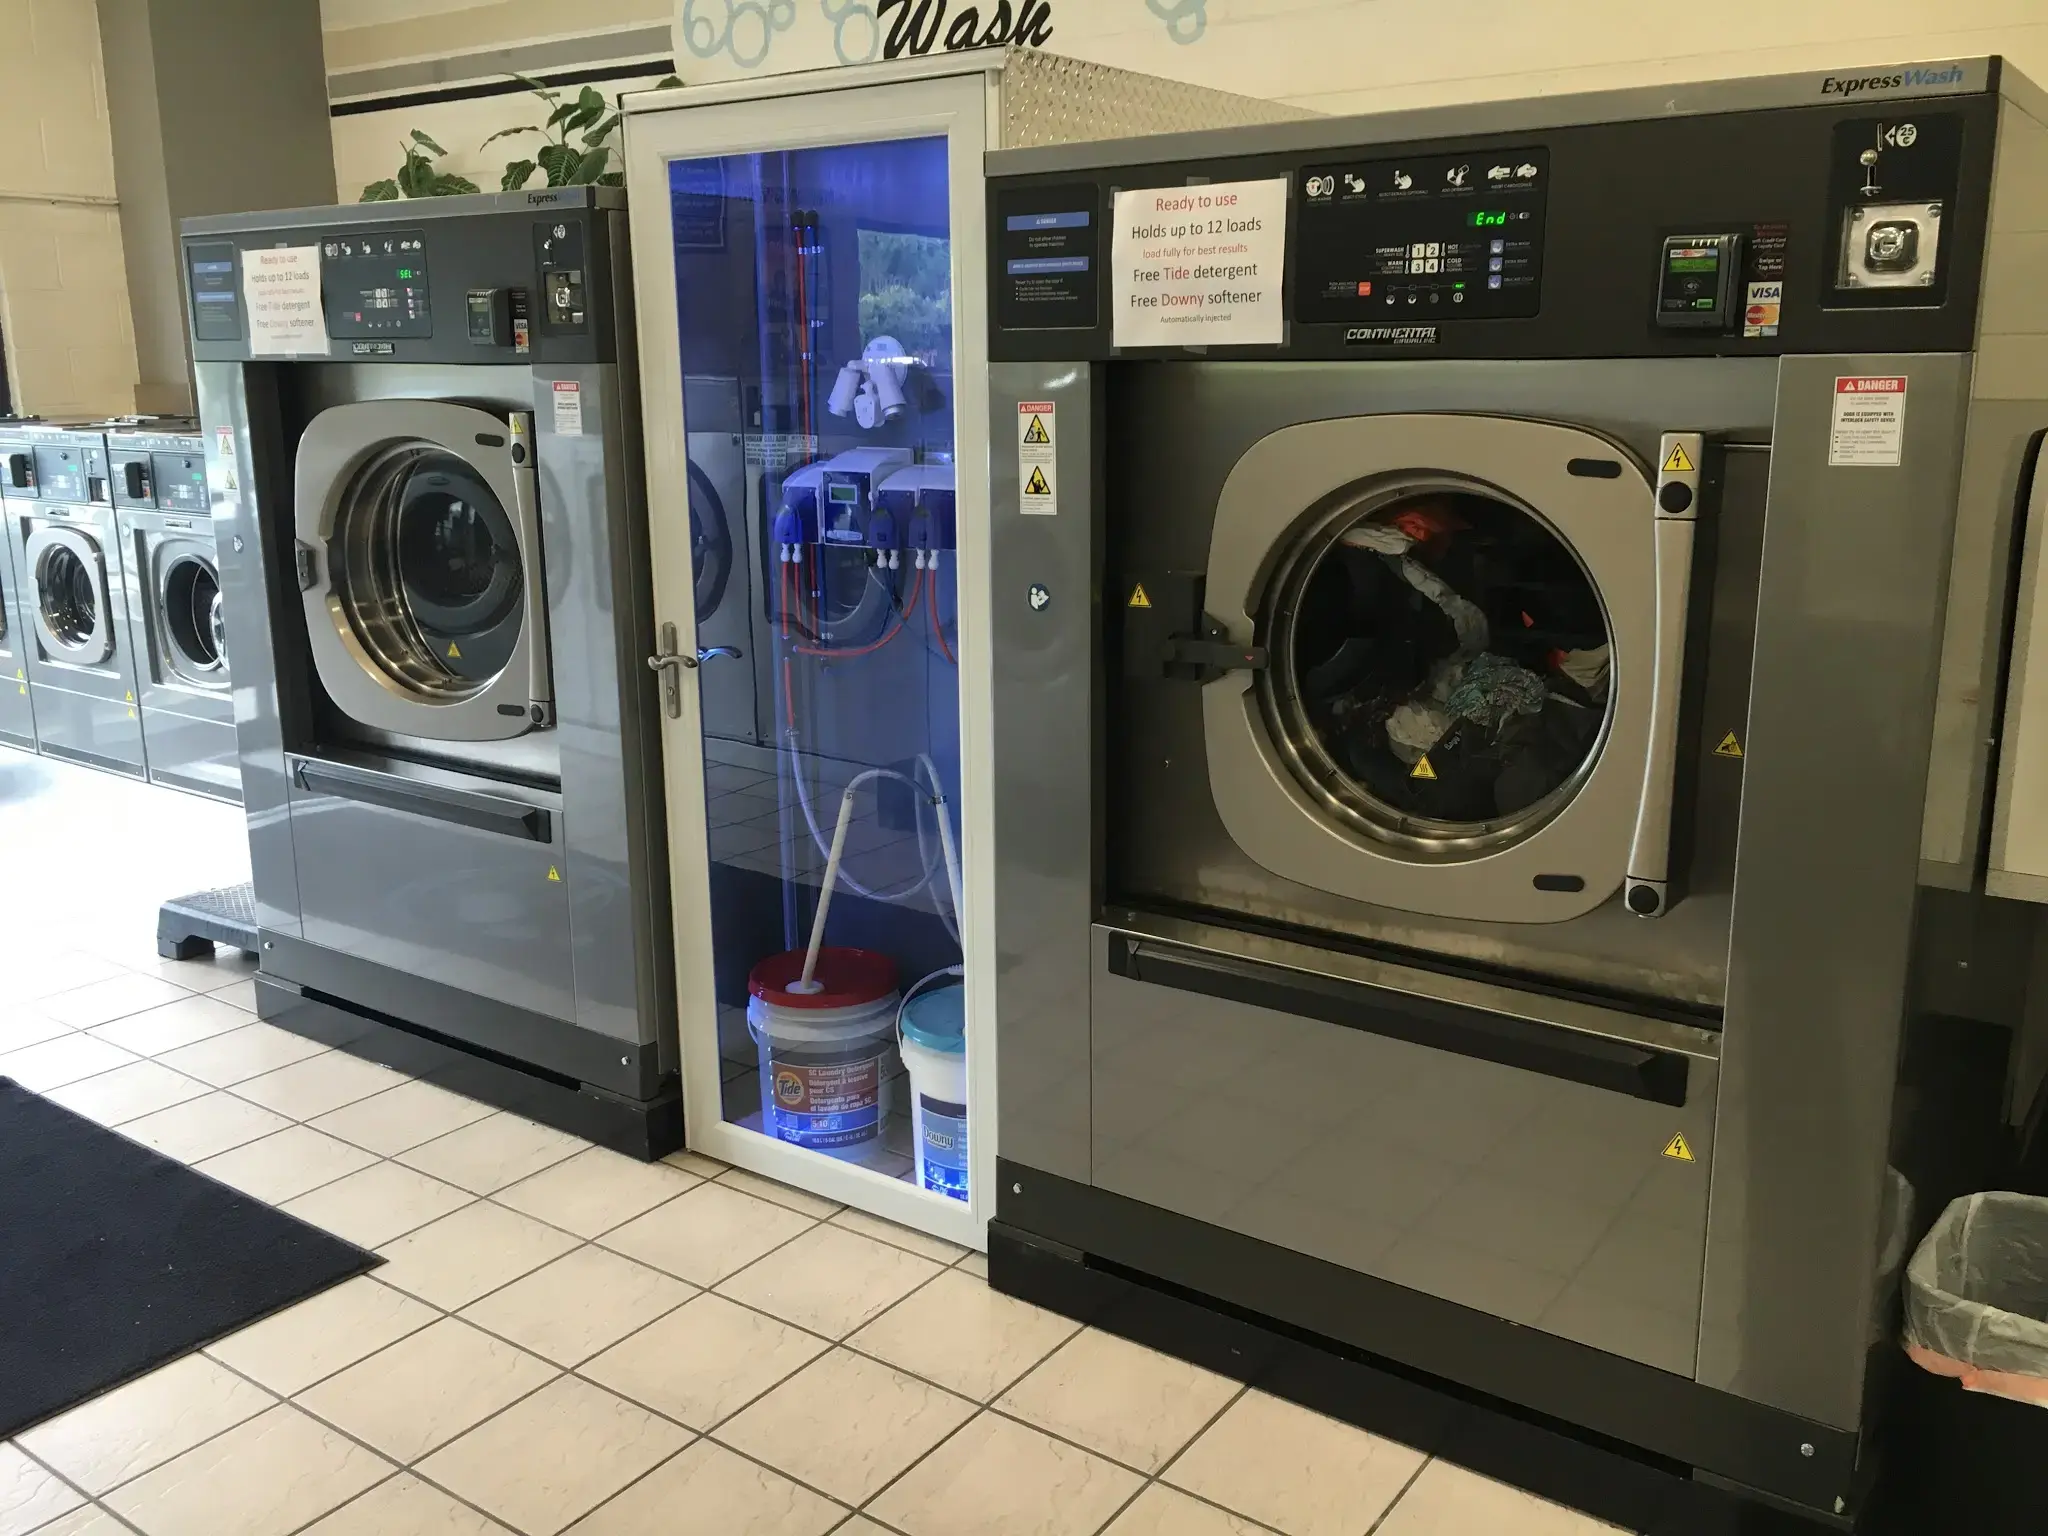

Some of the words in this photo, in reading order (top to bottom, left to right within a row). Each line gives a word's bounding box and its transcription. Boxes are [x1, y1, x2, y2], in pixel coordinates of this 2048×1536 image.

[877, 0, 1053, 60] Wash
[1821, 65, 1963, 97] ExpressWash
[1156, 195, 1195, 212] Ready
[1198, 196, 1212, 208] to
[1215, 194, 1238, 206] use
[1476, 212, 1506, 226] End
[1131, 224, 1167, 239] Holds
[1170, 226, 1187, 240] up
[1190, 223, 1203, 236] to
[1207, 220, 1223, 234] 12
[1226, 217, 1262, 232] loads
[1142, 248, 1161, 259] load
[1162, 246, 1181, 259] fully
[1183, 246, 1195, 257] for
[1197, 244, 1216, 256] best
[1218, 243, 1248, 254] results
[1133, 268, 1160, 282] Free
[1163, 266, 1190, 280] Tide
[1193, 263, 1258, 280] detergent
[1130, 294, 1158, 308] Free
[1161, 293, 1205, 308] Downy
[1207, 289, 1262, 305] softener
[1752, 287, 1780, 299] VISA
[1160, 314, 1204, 324] Automatically
[1204, 313, 1232, 323] injected
[1347, 327, 1437, 340] CONTINENTAL
[1857, 379, 1899, 391] DANGER
[1026, 404, 1052, 412] DANGER
[779, 1080, 801, 1097] Tide
[923, 1125, 954, 1149] Downy
